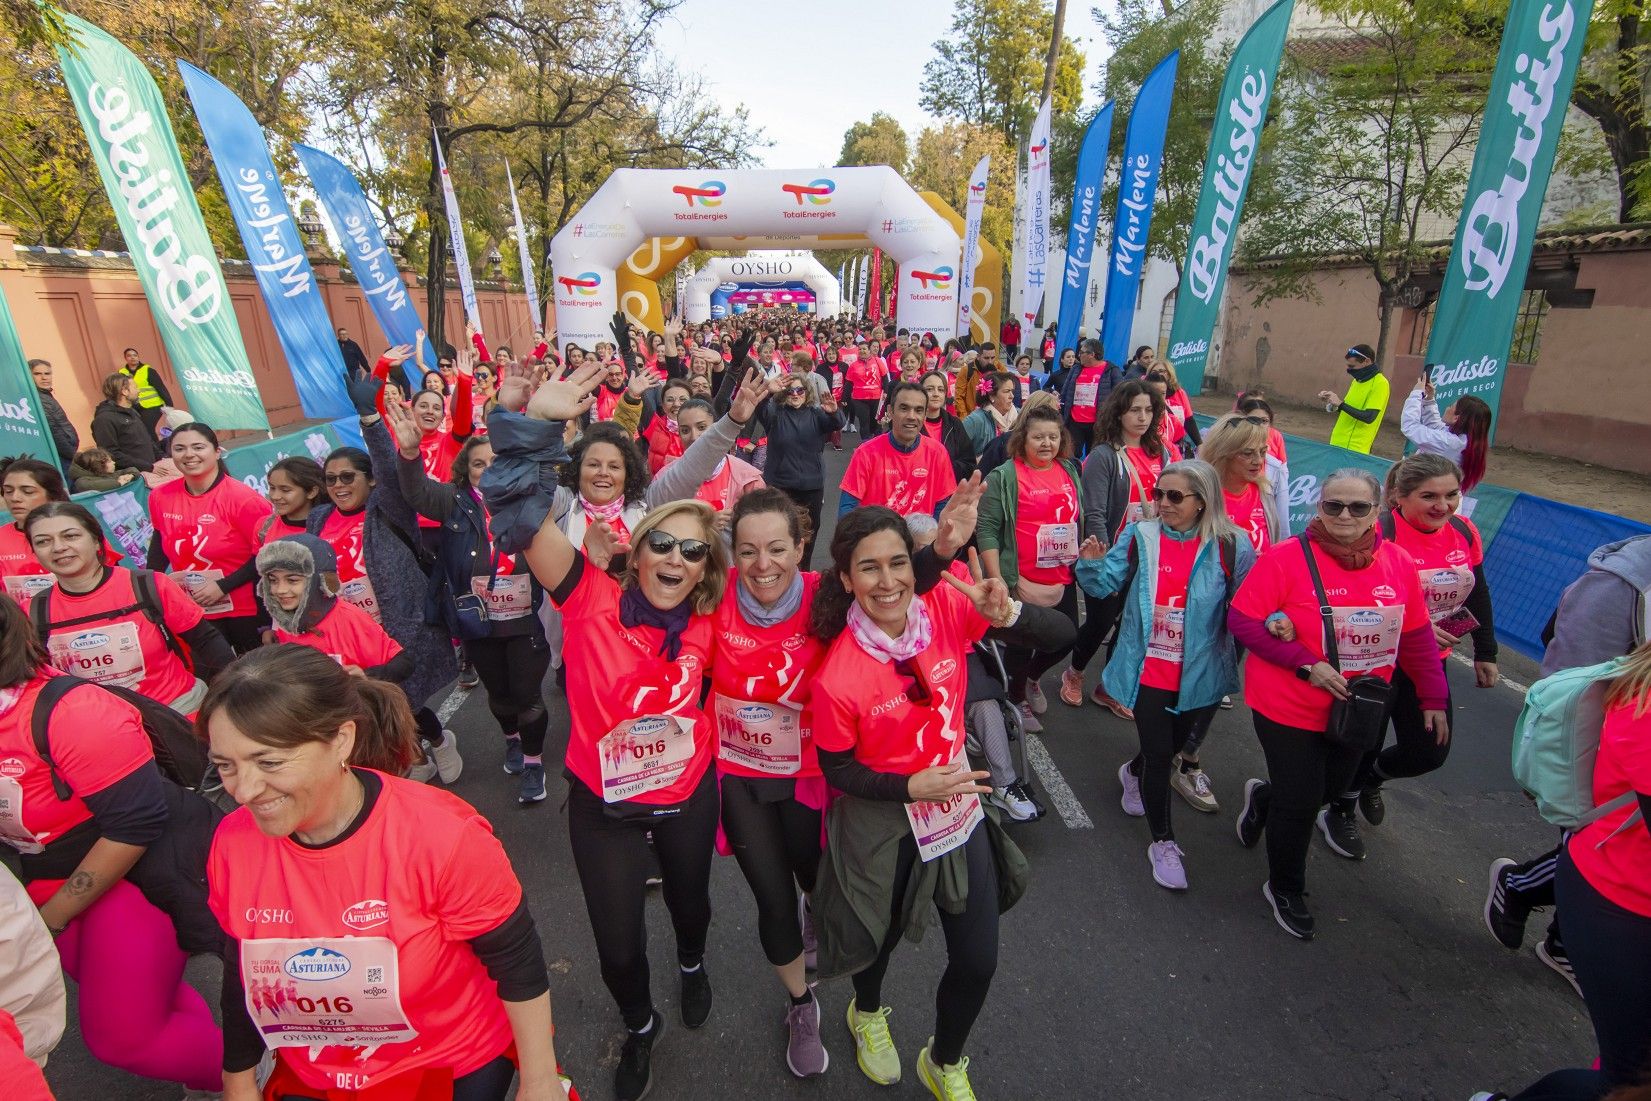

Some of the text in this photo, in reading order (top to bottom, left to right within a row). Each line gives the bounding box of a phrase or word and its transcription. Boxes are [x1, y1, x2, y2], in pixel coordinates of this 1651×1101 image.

[1189, 68, 1267, 305] Batiste
[674, 212, 728, 222] TotalEnergies
[783, 210, 836, 219] TotalEnergies
[1116, 154, 1151, 277] Marlene
[1066, 186, 1095, 289] Marlene
[731, 261, 792, 276] OYSHO
[910, 293, 953, 302] TotalEnergies
[1170, 338, 1208, 359] Batiste
[1430, 355, 1499, 388] Batiste
[1457, 387, 1469, 396] EN
[1472, 381, 1496, 394] SECO
[1053, 542, 1069, 551] 016
[491, 594, 514, 603] 016
[1433, 590, 1458, 602] 016
[722, 632, 757, 648] OYSHO
[1351, 634, 1381, 645] 016
[80, 654, 114, 669] 016
[871, 692, 908, 716] OYSHO
[631, 722, 667, 734] ASTURIANA
[741, 730, 773, 746] 016
[633, 739, 666, 759] 016
[614, 782, 644, 796] OYSHO
[930, 836, 957, 853] OYSHO
[245, 907, 294, 924] OYSHO
[253, 965, 281, 974] SUMA
[290, 960, 346, 975] ASTURIANA
[296, 996, 354, 1014] 016
[282, 1024, 314, 1032] CARRERA
[318, 1018, 346, 1026] 6275
[355, 1034, 399, 1042] Santander
[336, 1072, 352, 1090] DE
